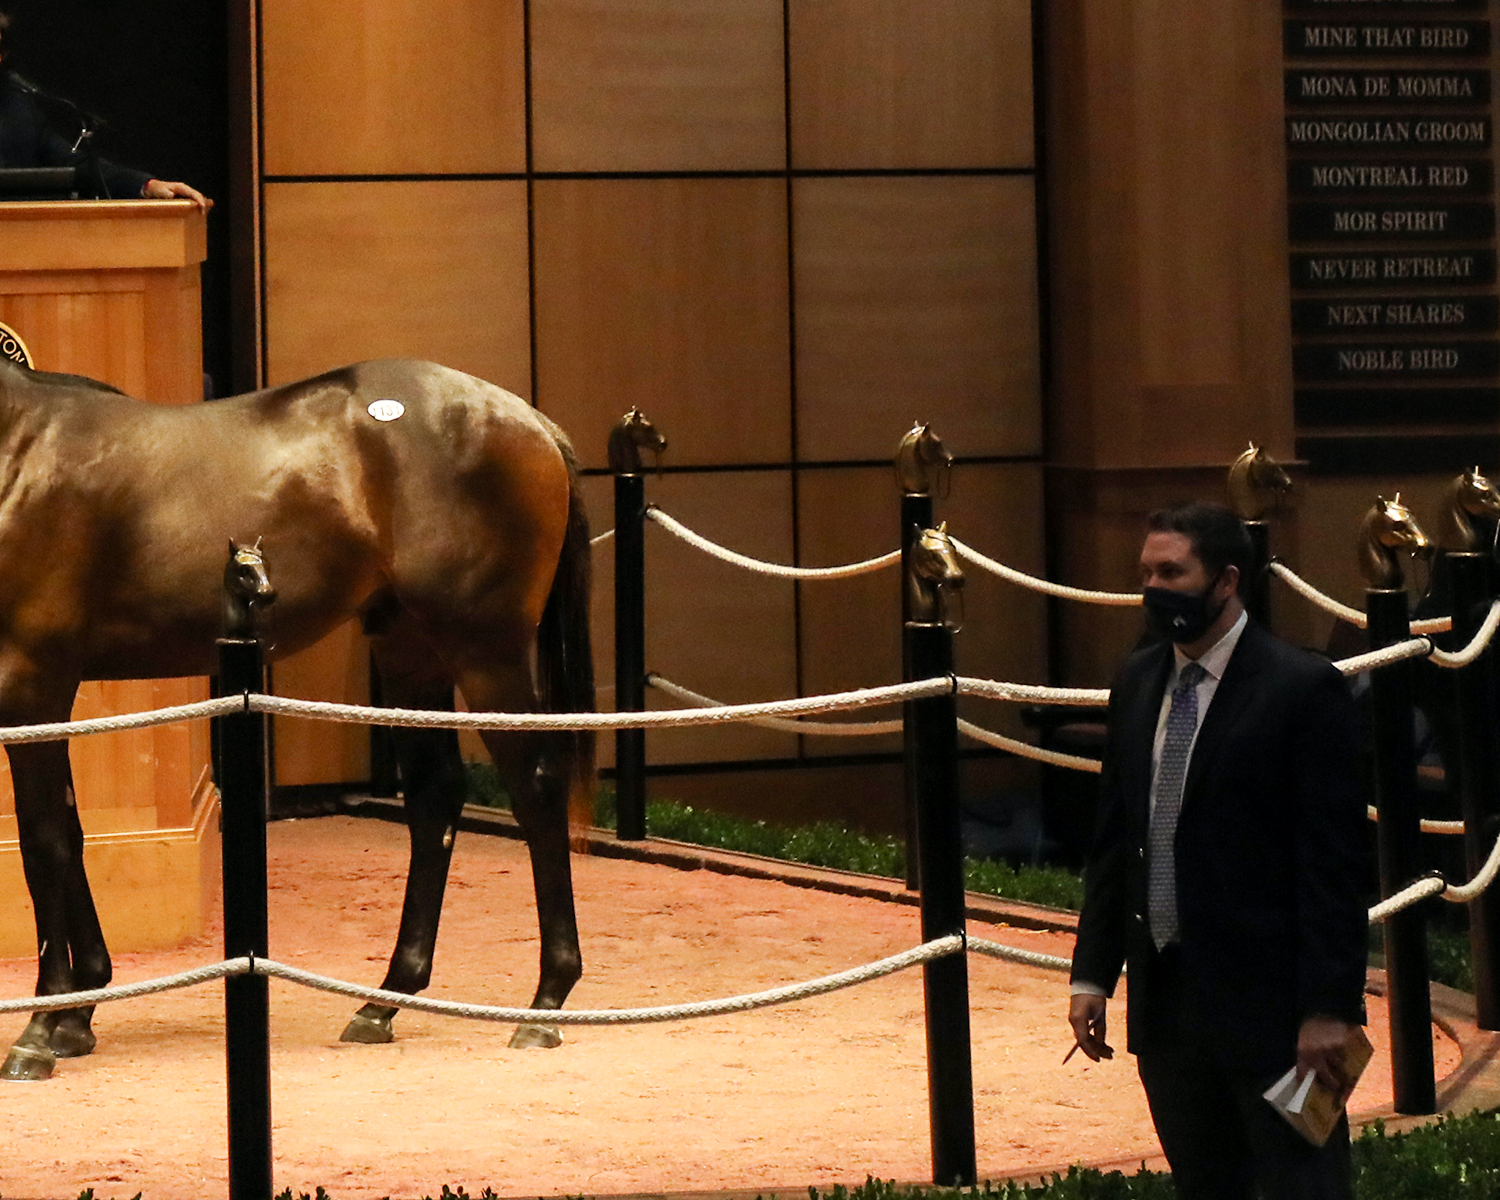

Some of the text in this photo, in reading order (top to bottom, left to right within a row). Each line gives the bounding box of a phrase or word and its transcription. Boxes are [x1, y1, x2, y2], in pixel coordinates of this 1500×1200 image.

[1304, 26, 1469, 48] MINE THAT BIRD
[1301, 75, 1474, 97] MONA DE MOMMA
[1290, 121, 1486, 142] MONGOLIAN GROOM
[1312, 166, 1469, 187] MONTREAL RED
[1333, 210, 1449, 232] MOR SPIRIT
[1308, 256, 1474, 280] NEVER RETREAT
[1326, 303, 1466, 326] NEXT SHARES
[1337, 349, 1459, 371] NOBLE BIRD
